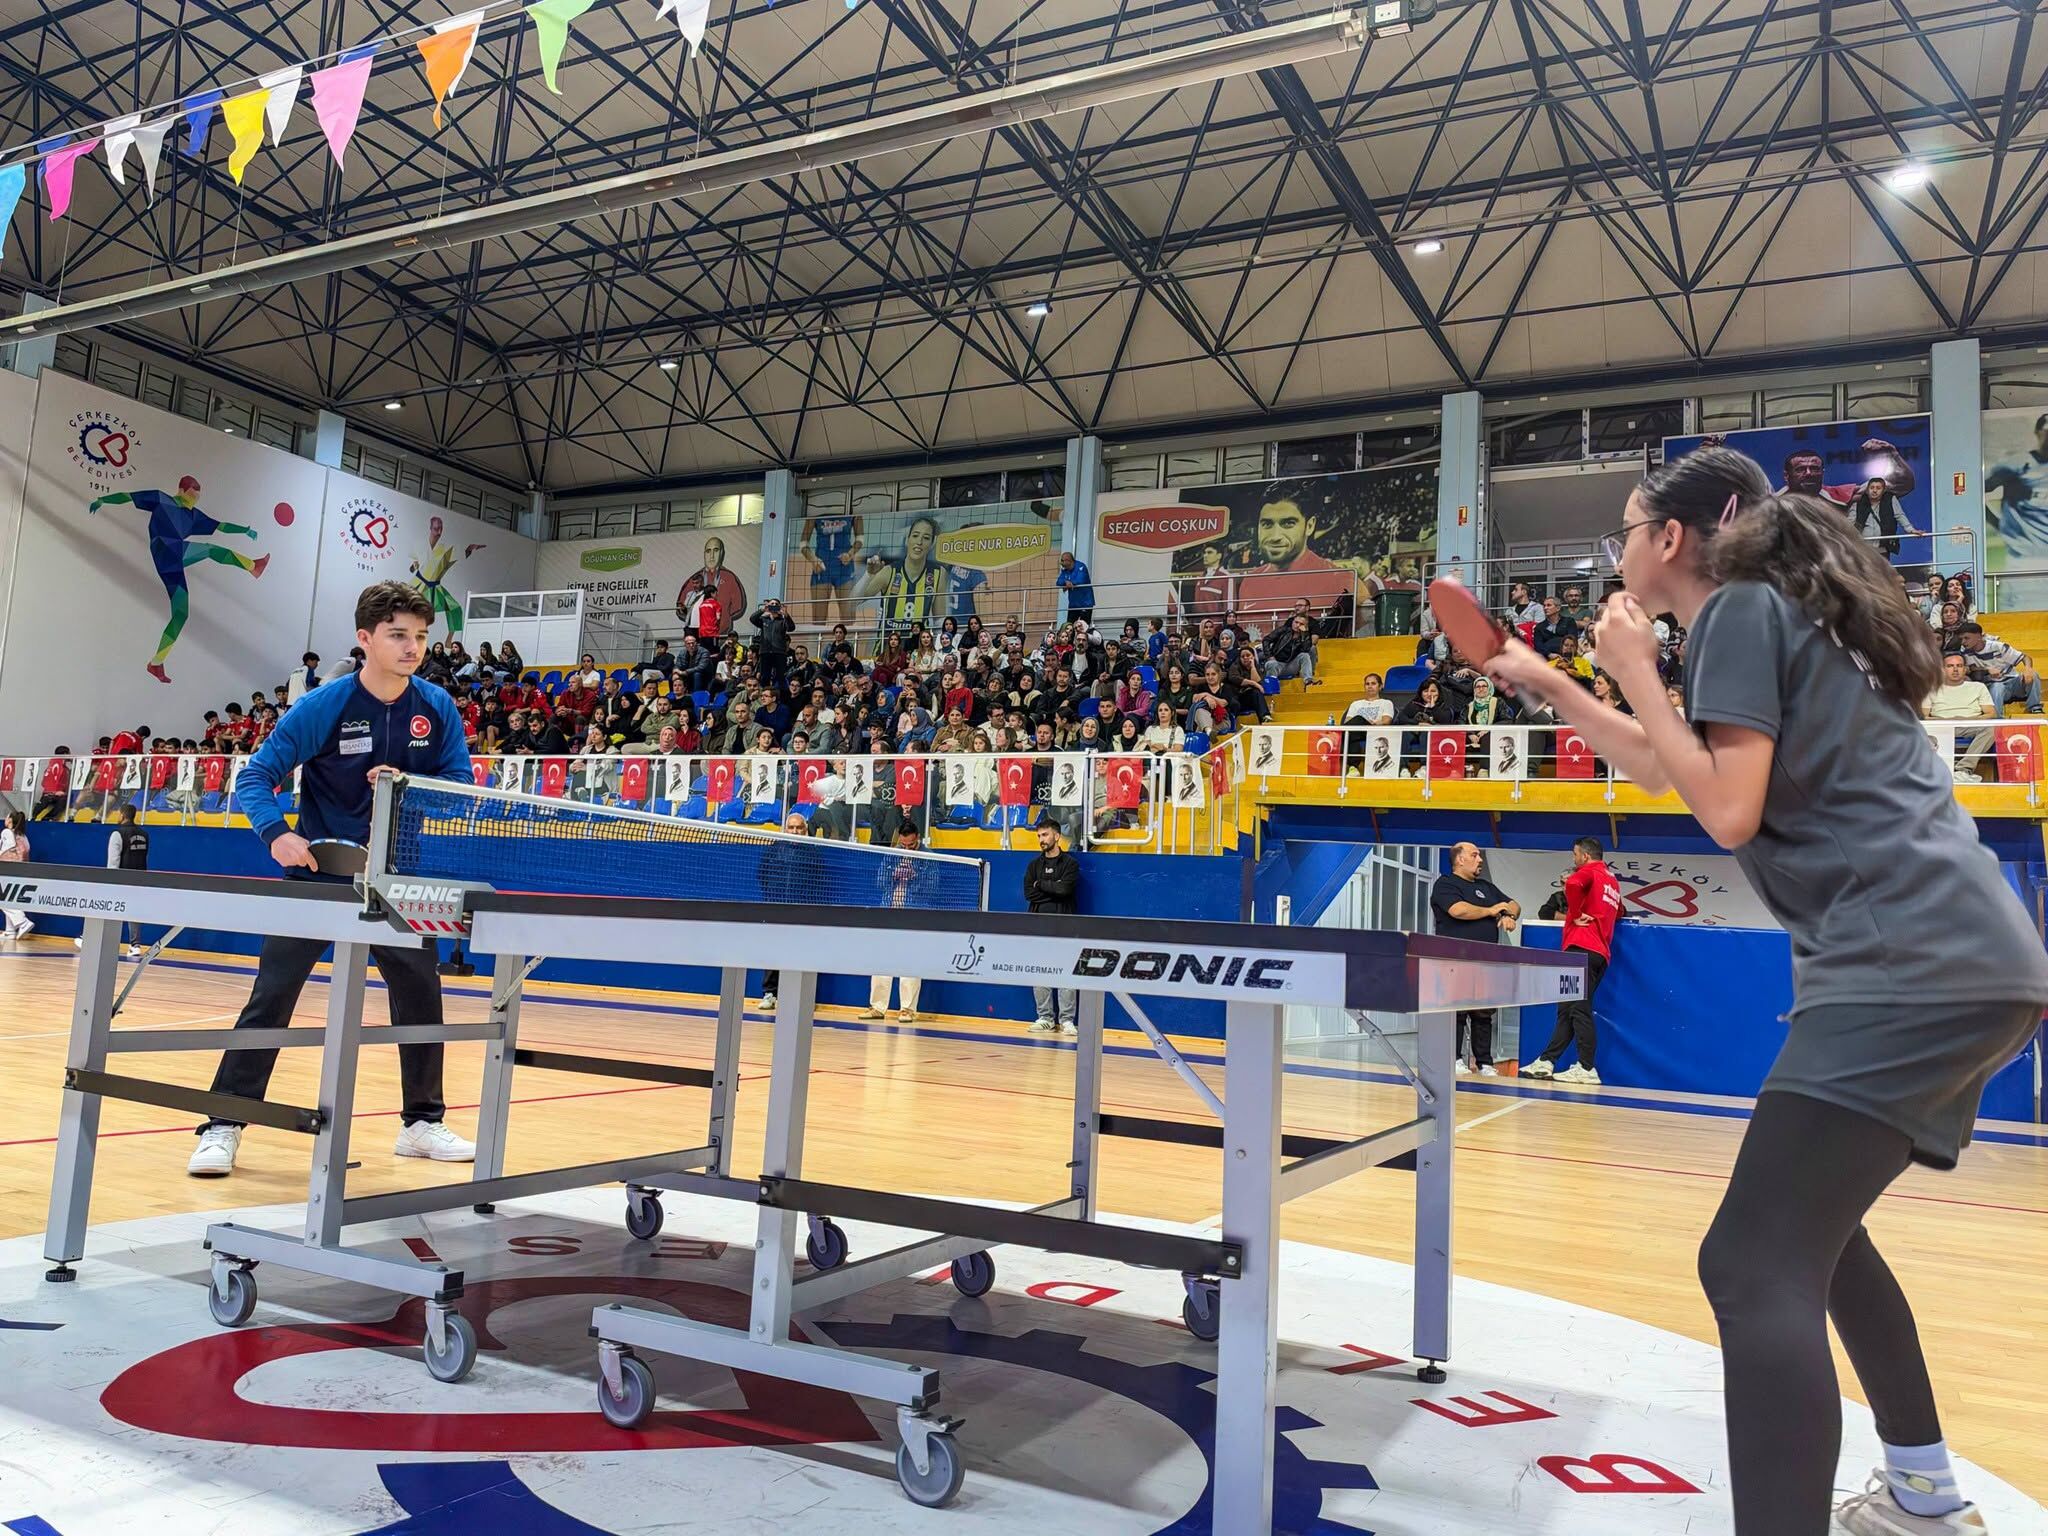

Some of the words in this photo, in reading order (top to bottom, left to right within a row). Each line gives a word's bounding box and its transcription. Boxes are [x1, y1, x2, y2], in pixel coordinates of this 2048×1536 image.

[90, 482, 110, 493] 1911
[1108, 518, 1154, 534] SEZGİN
[1159, 518, 1217, 534] COŞKUN
[942, 537, 975, 553] DİCLE
[978, 538, 1002, 551] NUR
[1006, 534, 1046, 549] BABAT
[597, 578, 648, 592] ENGELLİLER
[592, 596, 604, 606] VE
[607, 592, 656, 606] OLİMPİYAT
[408, 740, 429, 748] STIGA
[386, 883, 462, 902] DONIC
[38, 894, 77, 908] WALDNER
[79, 898, 112, 911] CLASSIC
[114, 901, 126, 912] 25
[398, 901, 454, 915] STRESS
[992, 963, 1013, 973] MADE
[1015, 964, 1023, 973] IN
[1025, 965, 1064, 975] GERMANY
[1072, 948, 1294, 990] DONIC
[1559, 974, 1580, 995] DONIC
